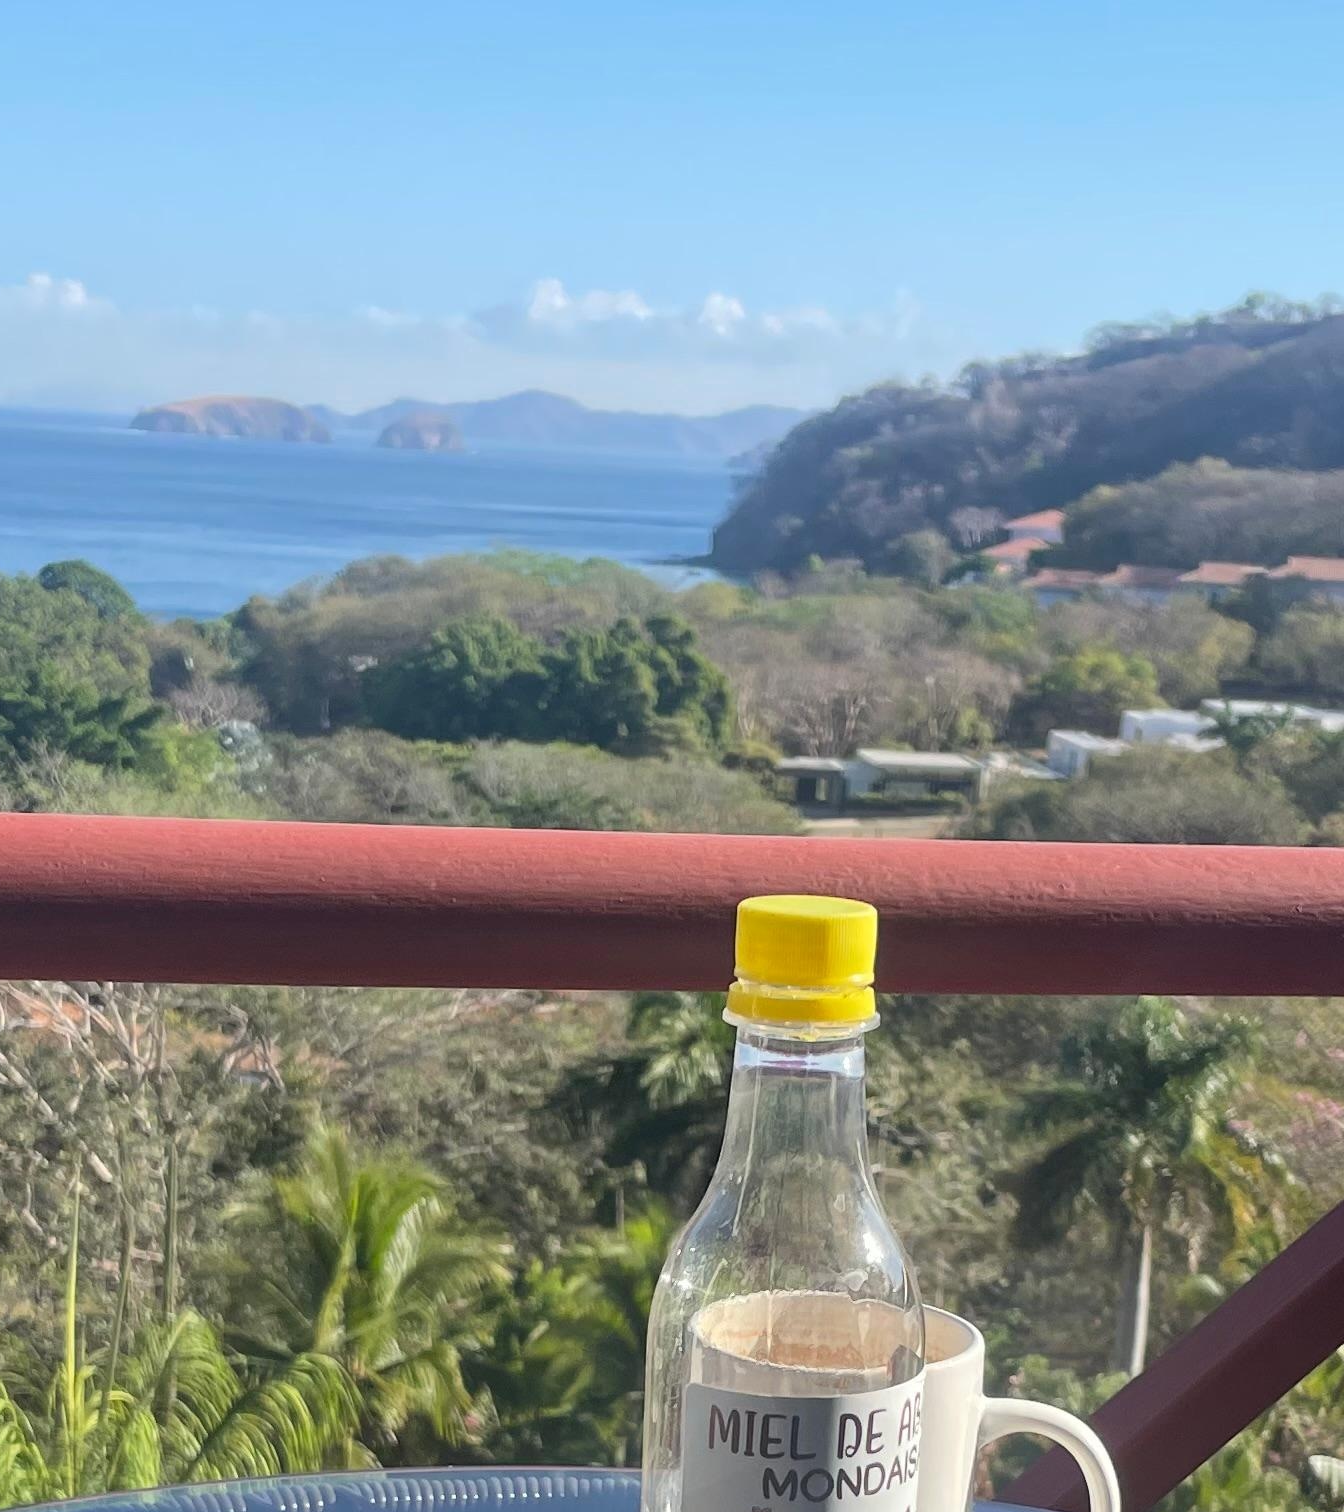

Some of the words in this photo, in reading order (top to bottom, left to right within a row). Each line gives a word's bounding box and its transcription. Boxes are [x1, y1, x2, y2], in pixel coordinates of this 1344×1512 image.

[708, 1404, 816, 1461] MIEL
[836, 1408, 887, 1460] DE
[762, 1444, 920, 1503] MONDAIS
